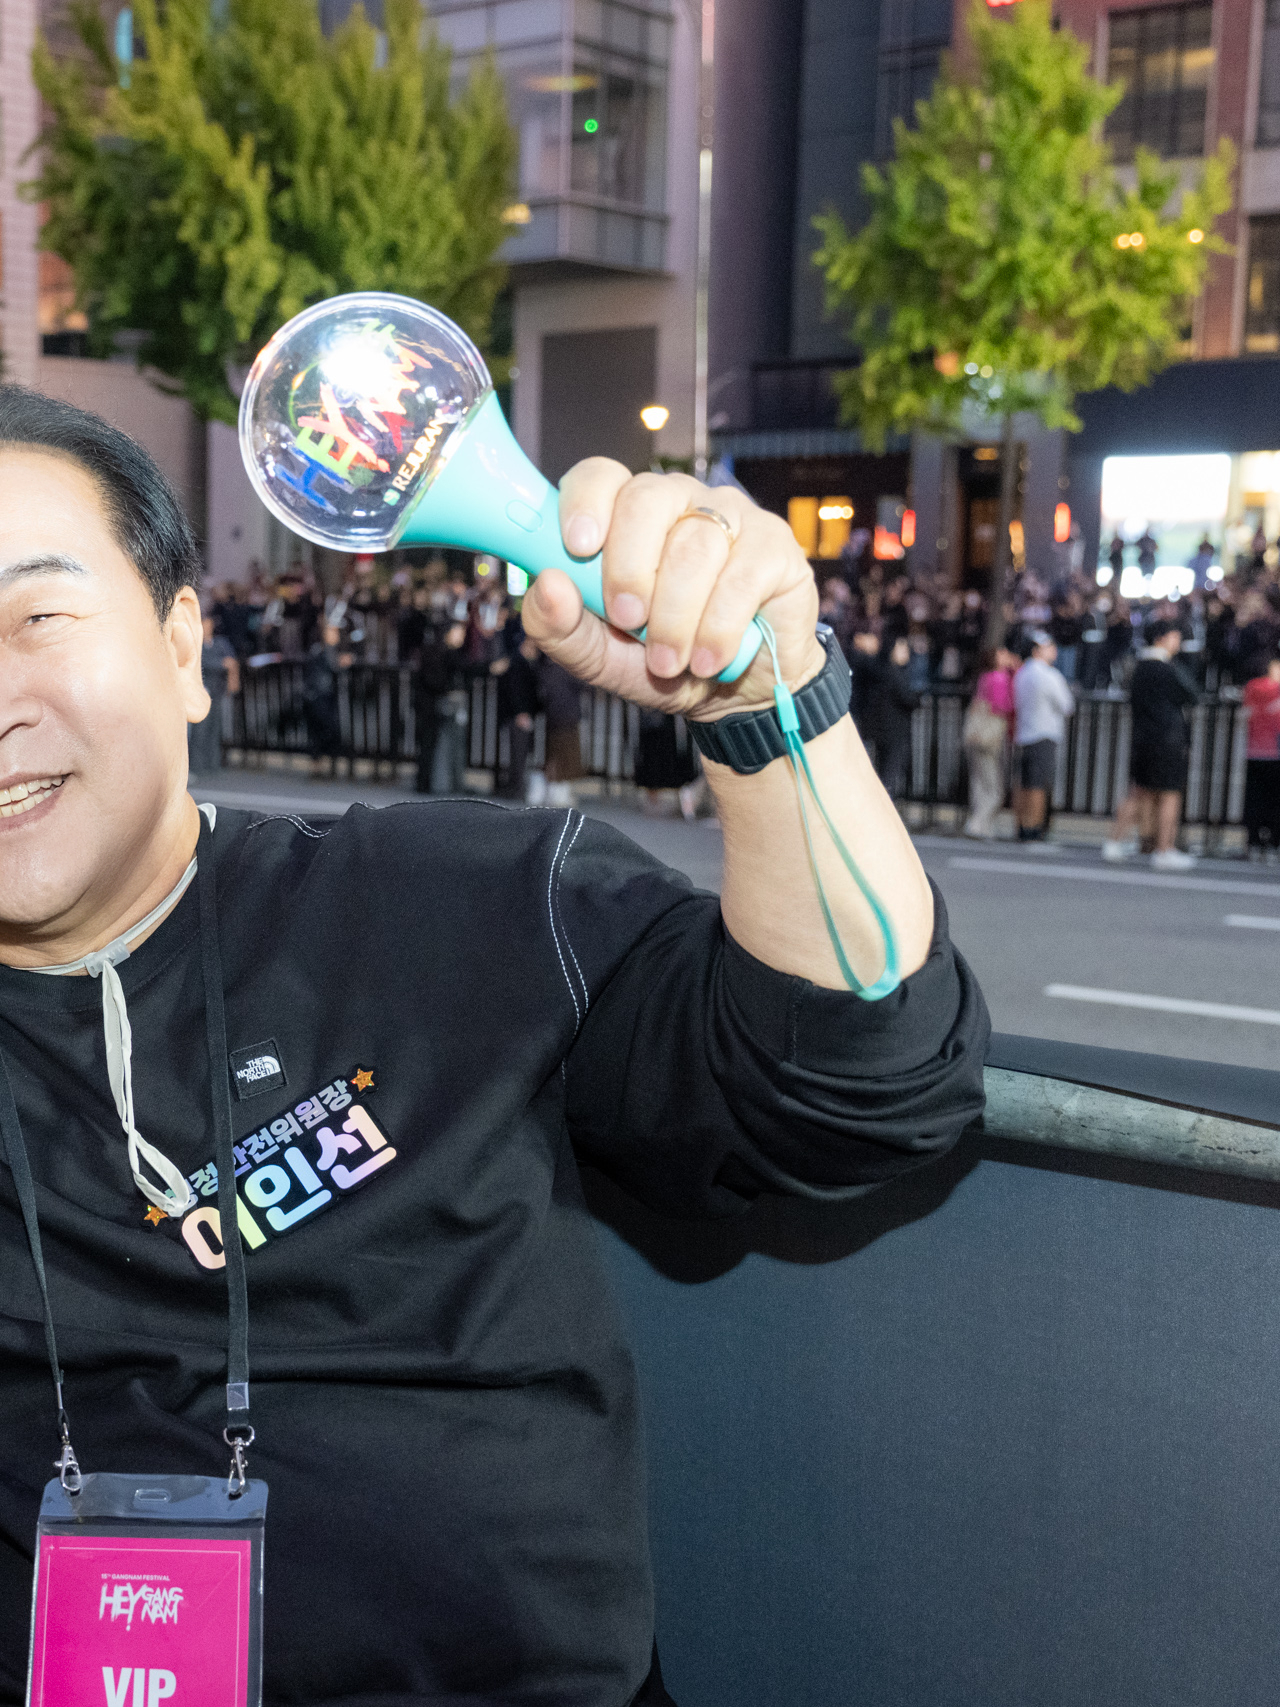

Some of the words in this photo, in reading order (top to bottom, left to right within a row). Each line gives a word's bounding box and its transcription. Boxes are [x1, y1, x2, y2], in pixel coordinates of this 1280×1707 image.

[392, 410, 447, 491] REJURAN
[236, 1064, 265, 1079] NORTH
[246, 1057, 263, 1068] THE
[246, 1069, 268, 1083] FACE
[165, 1079, 352, 1211] 정전위원장
[181, 1105, 397, 1269] 이인선
[102, 1667, 177, 1707] VIP
